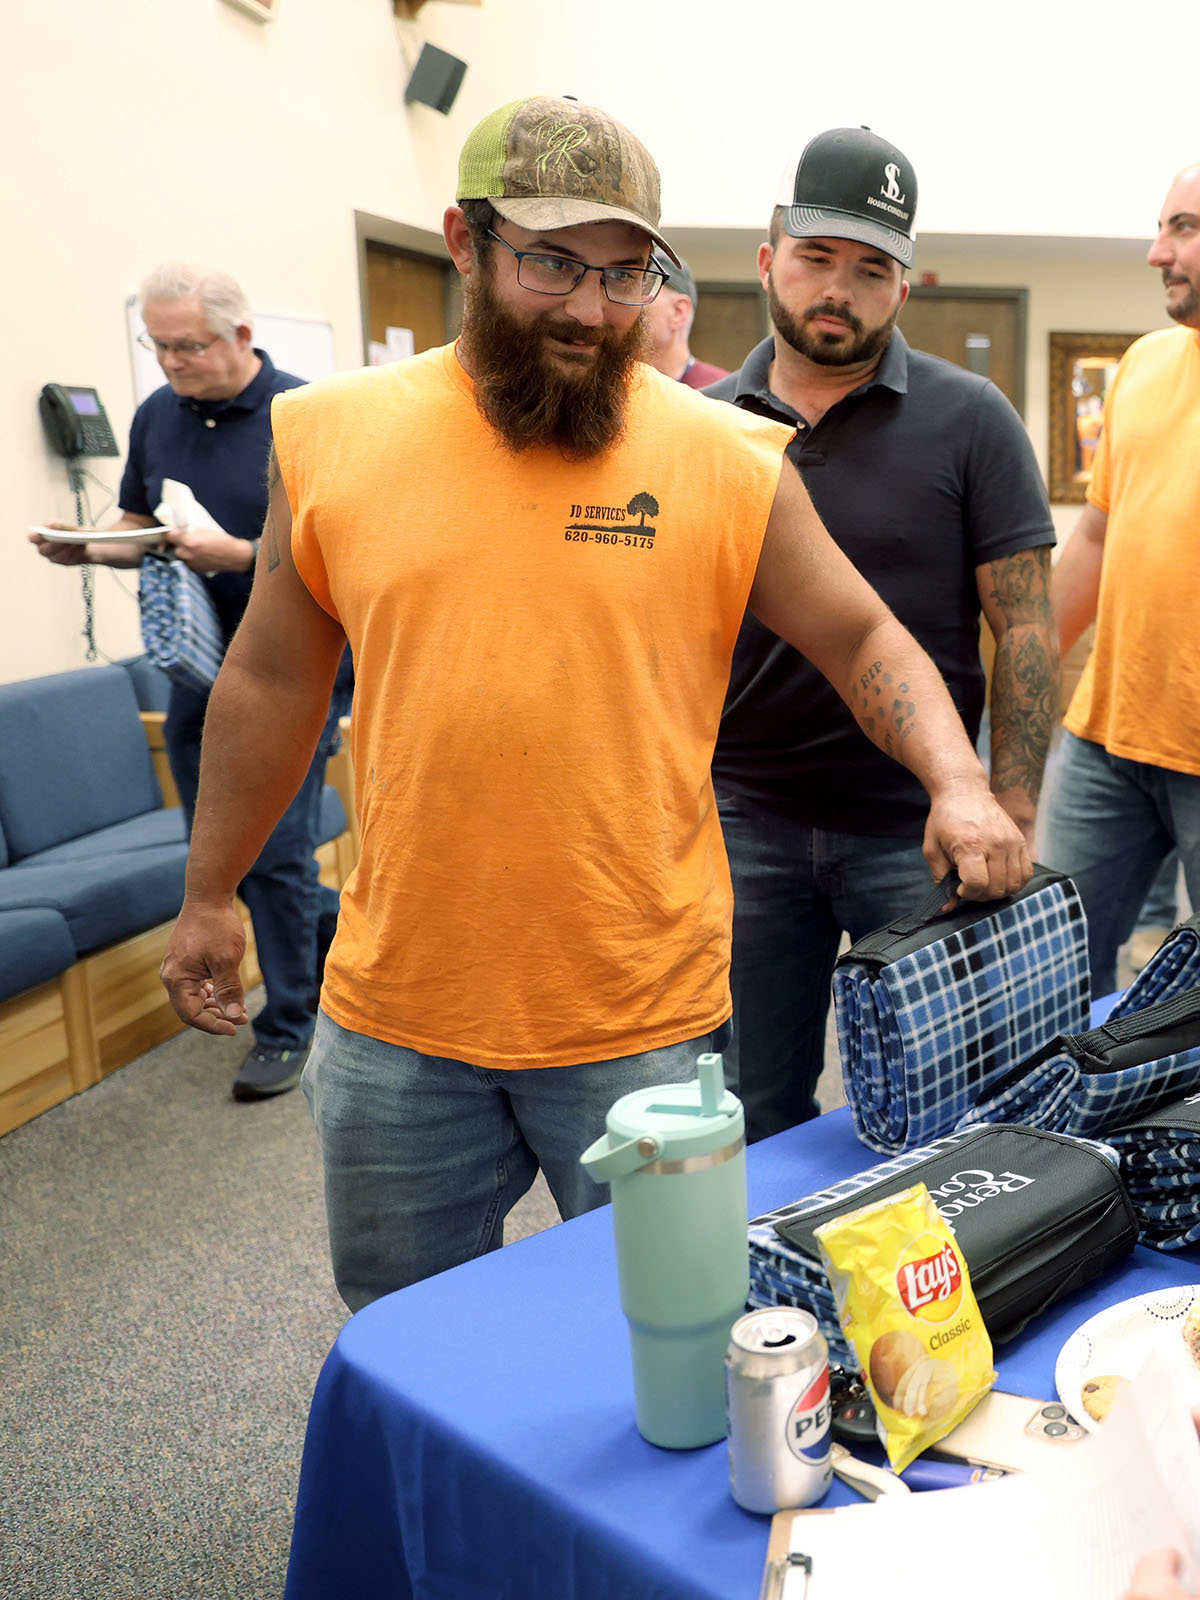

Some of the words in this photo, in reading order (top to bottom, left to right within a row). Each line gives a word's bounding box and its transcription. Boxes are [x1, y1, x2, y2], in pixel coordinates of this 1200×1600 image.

[569, 504, 582, 518] JD
[584, 505, 626, 521] SERVICES
[565, 530, 654, 549] 620-960-5175
[861, 661, 883, 690] RIP
[937, 1170, 1036, 1218] Reno
[903, 1245, 959, 1310] Lay's
[929, 1318, 972, 1351] Classic
